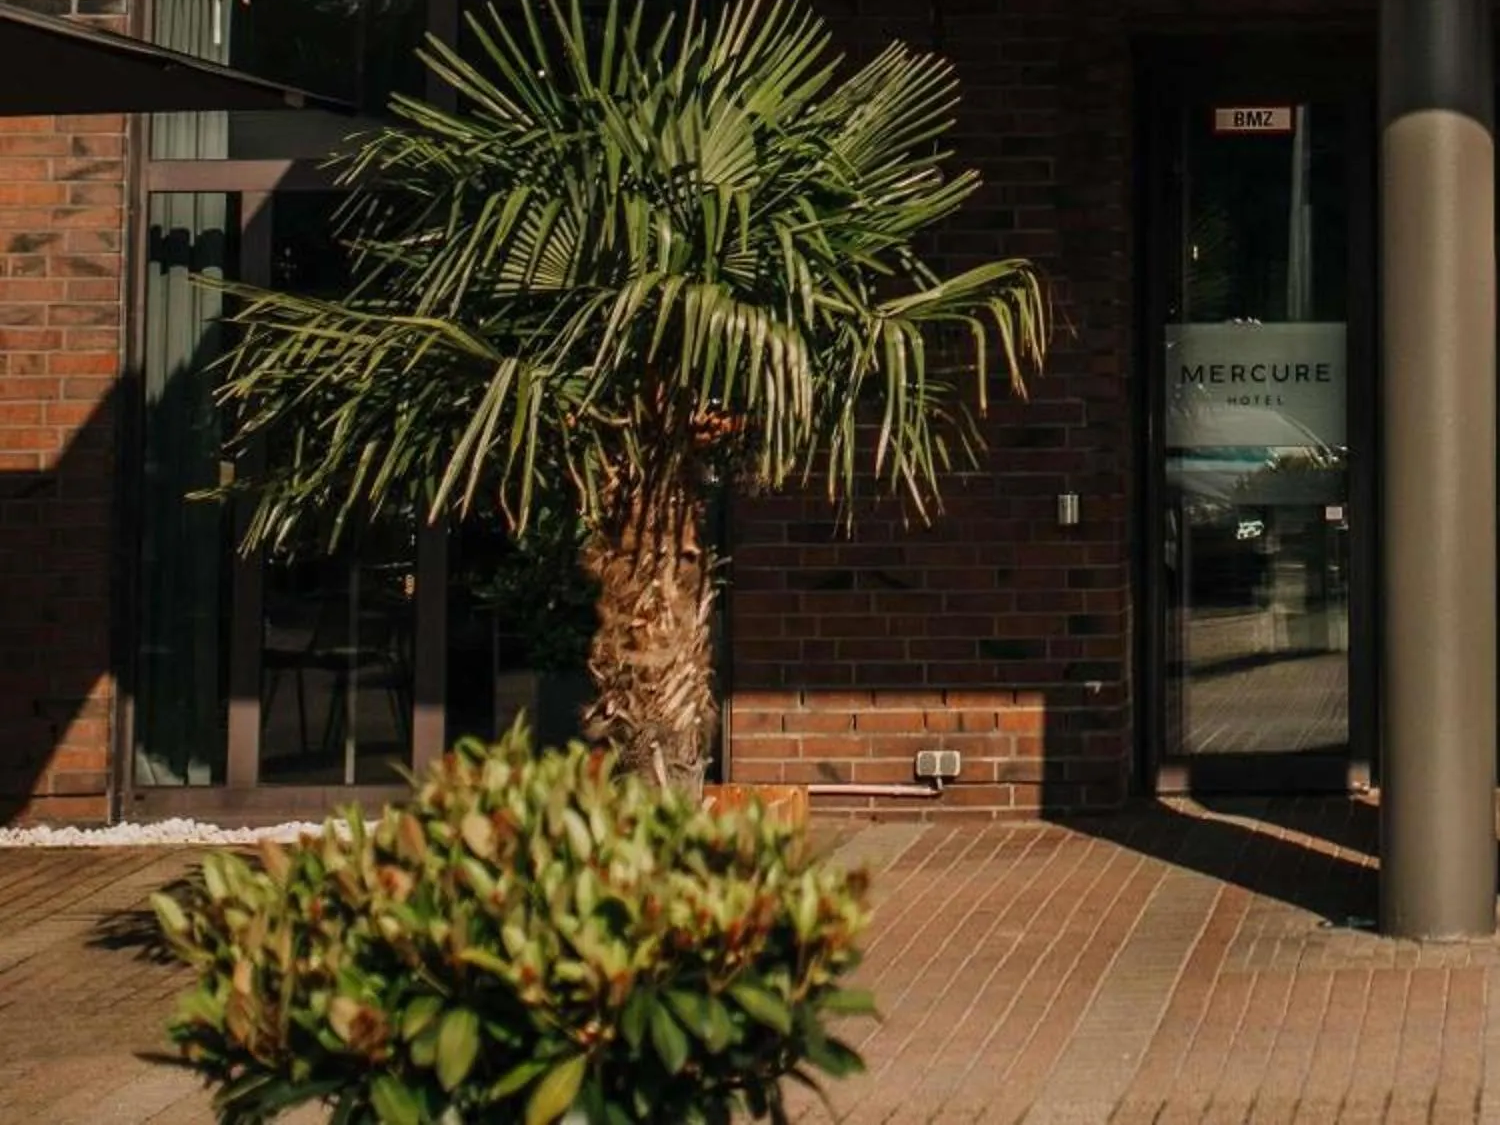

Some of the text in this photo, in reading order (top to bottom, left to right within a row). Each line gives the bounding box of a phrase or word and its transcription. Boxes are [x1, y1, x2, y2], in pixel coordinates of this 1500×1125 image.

[1233, 110, 1274, 127] BMZ
[1180, 362, 1331, 384] MERCURE
[1226, 394, 1285, 406] HOTEL
